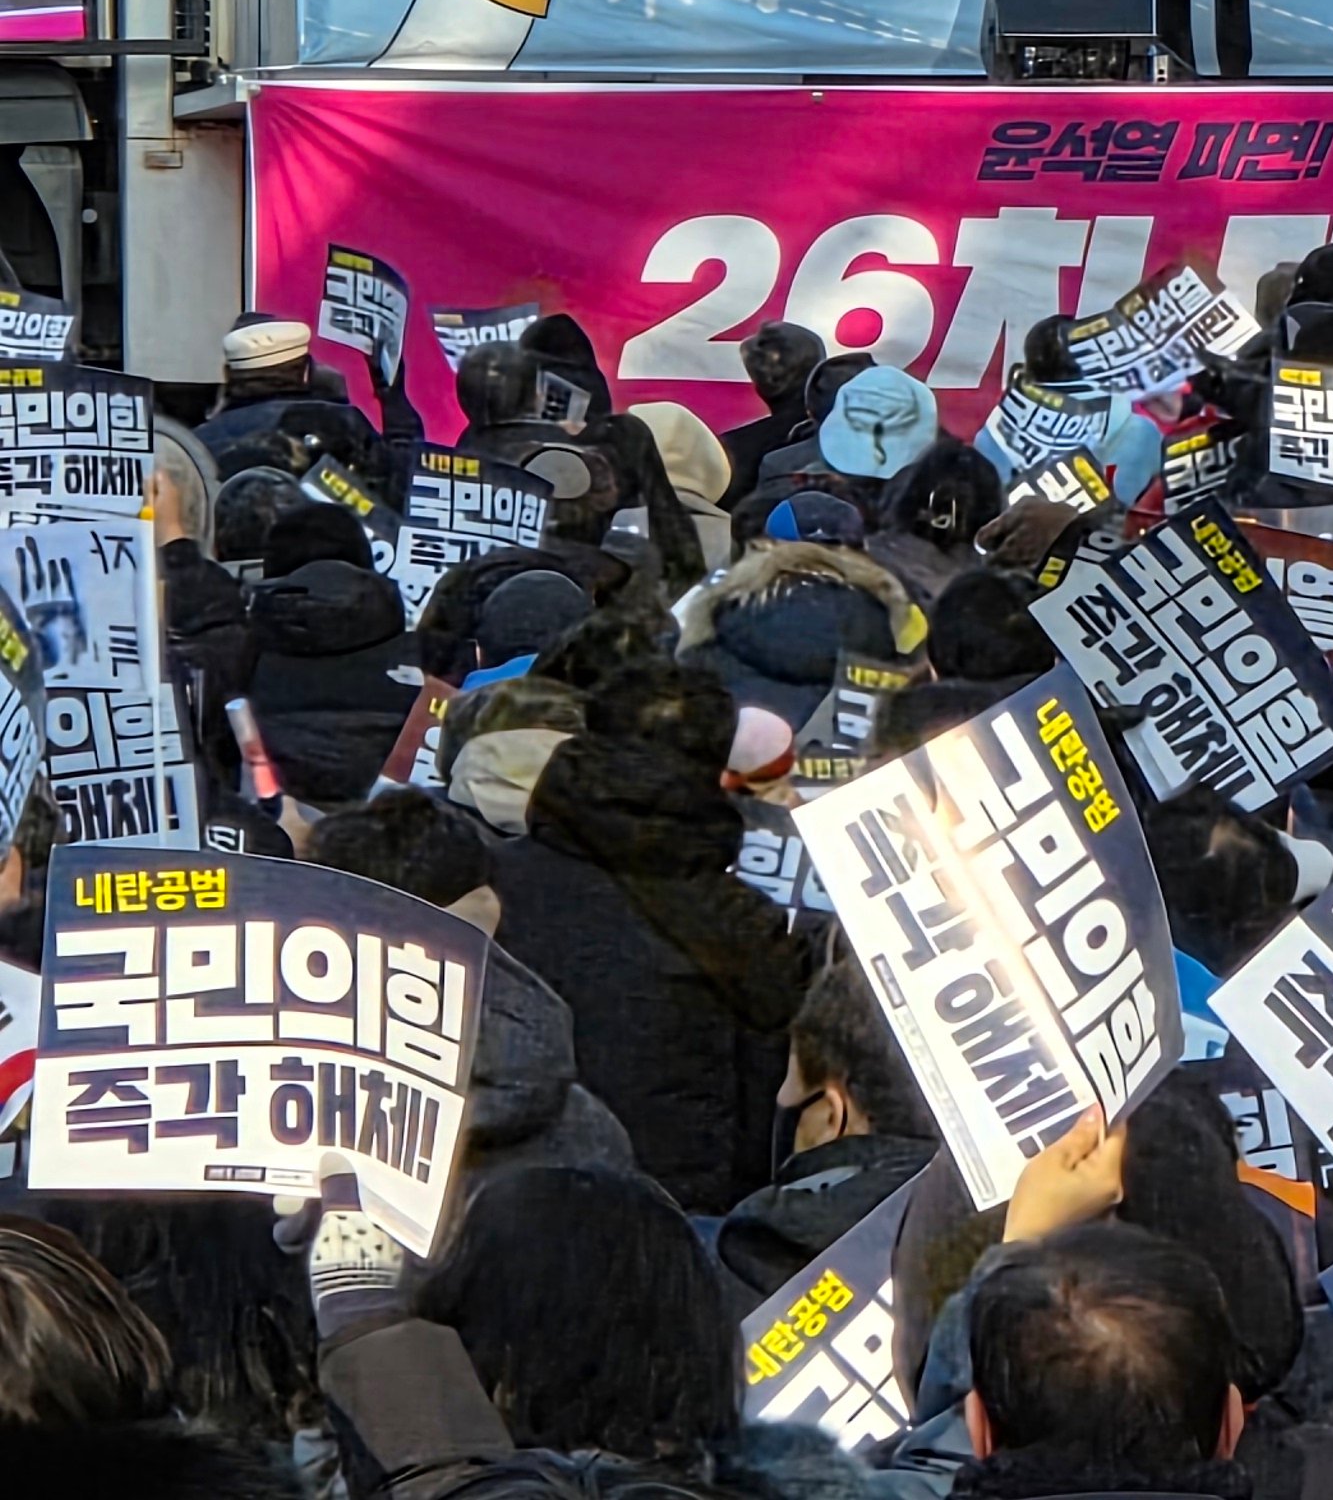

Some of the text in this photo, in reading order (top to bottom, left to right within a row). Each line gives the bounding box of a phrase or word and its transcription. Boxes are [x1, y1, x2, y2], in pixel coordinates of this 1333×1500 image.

[977, 119, 1180, 183] 윤석열
[1035, 697, 1122, 834] 내란공범
[74, 867, 228, 915] 내란공범
[844, 793, 976, 972] 즉각
[926, 711, 1162, 1127] 국민의힘
[53, 920, 468, 1088] 국민의힘
[65, 1054, 442, 1186] 즉각 해체!
[747, 1267, 854, 1386] 내란공범
